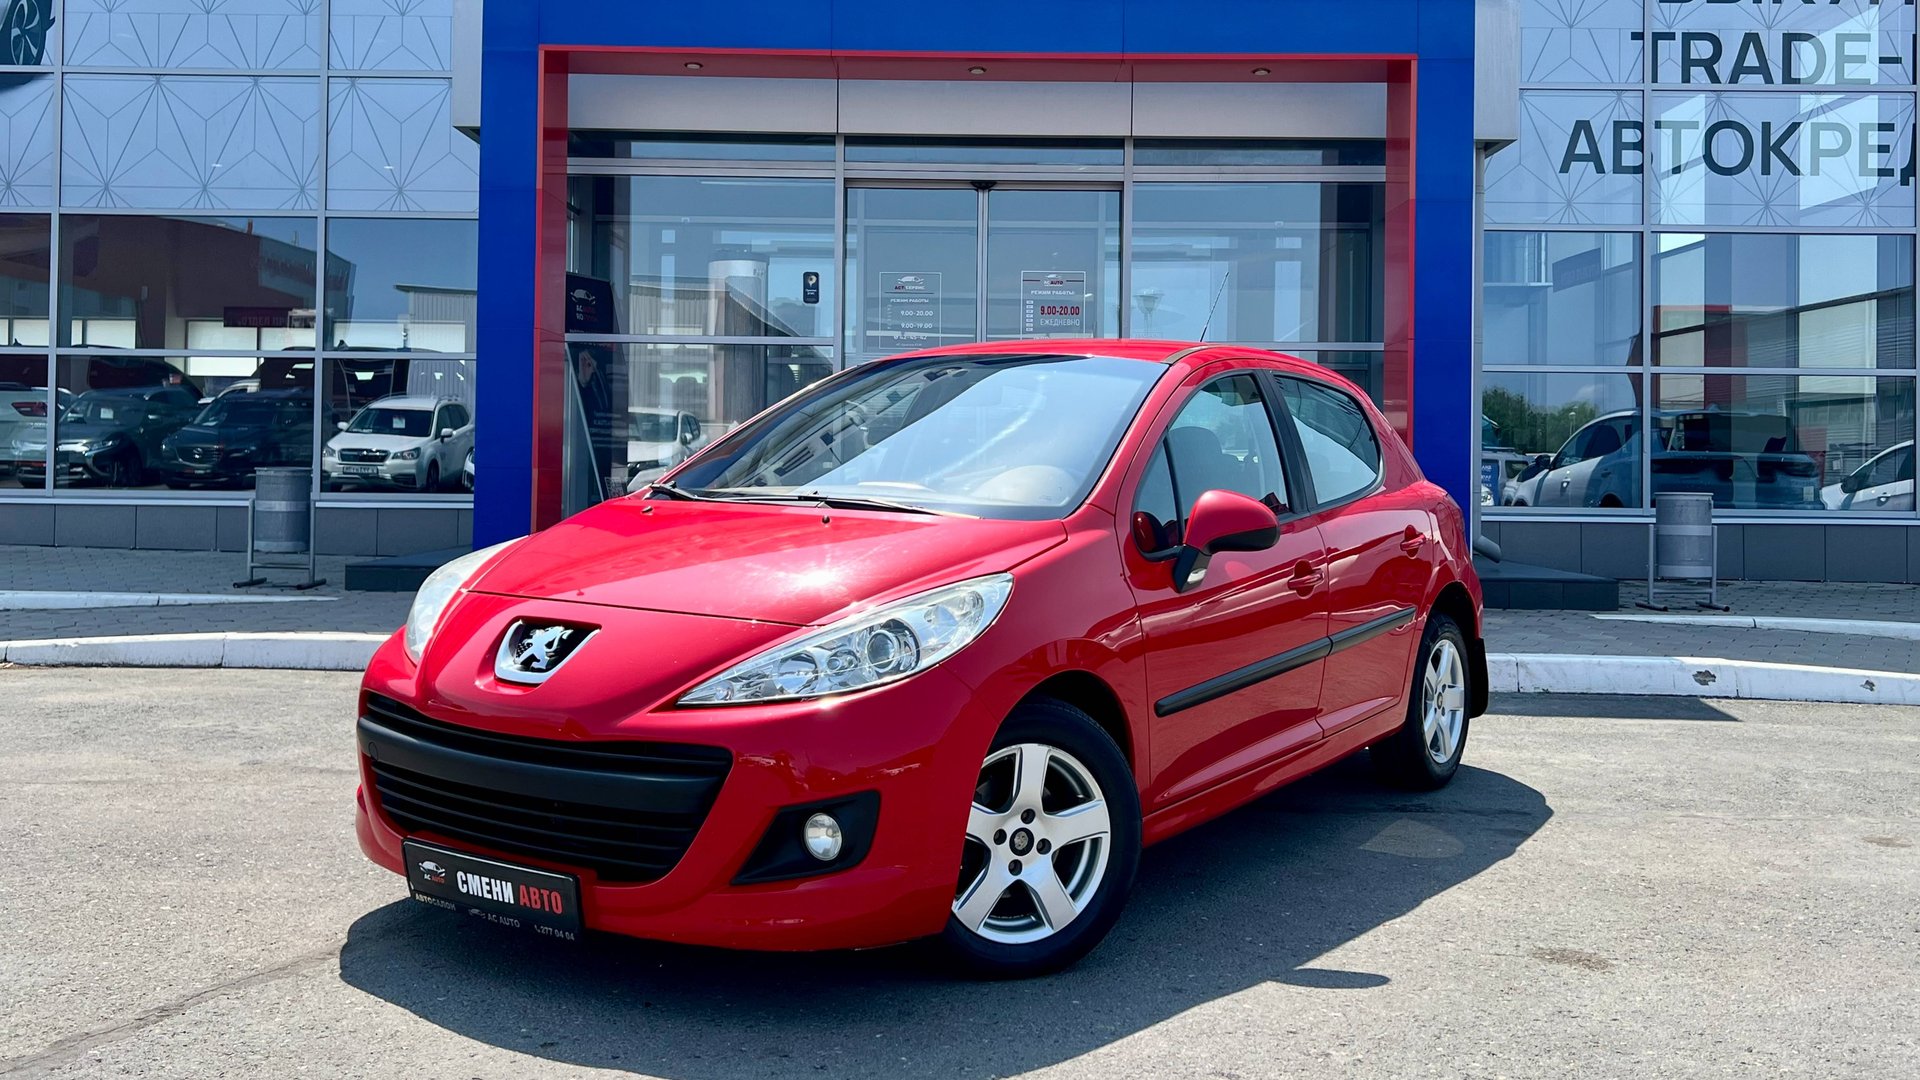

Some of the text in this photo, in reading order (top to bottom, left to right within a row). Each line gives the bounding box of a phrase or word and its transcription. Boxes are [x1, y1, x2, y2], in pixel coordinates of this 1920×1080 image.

[1040, 305, 1080, 315] 9.00-20.00
[1040, 318, 1080, 326] ЕЖЕДНЕВНО
[456, 871, 563, 915] СМЕНИ АВТО
[415, 893, 456, 912] АВТОСАЛОН
[499, 916, 520, 928] AUTO
[554, 929, 564, 938] 04
[565, 931, 575, 941] 04
